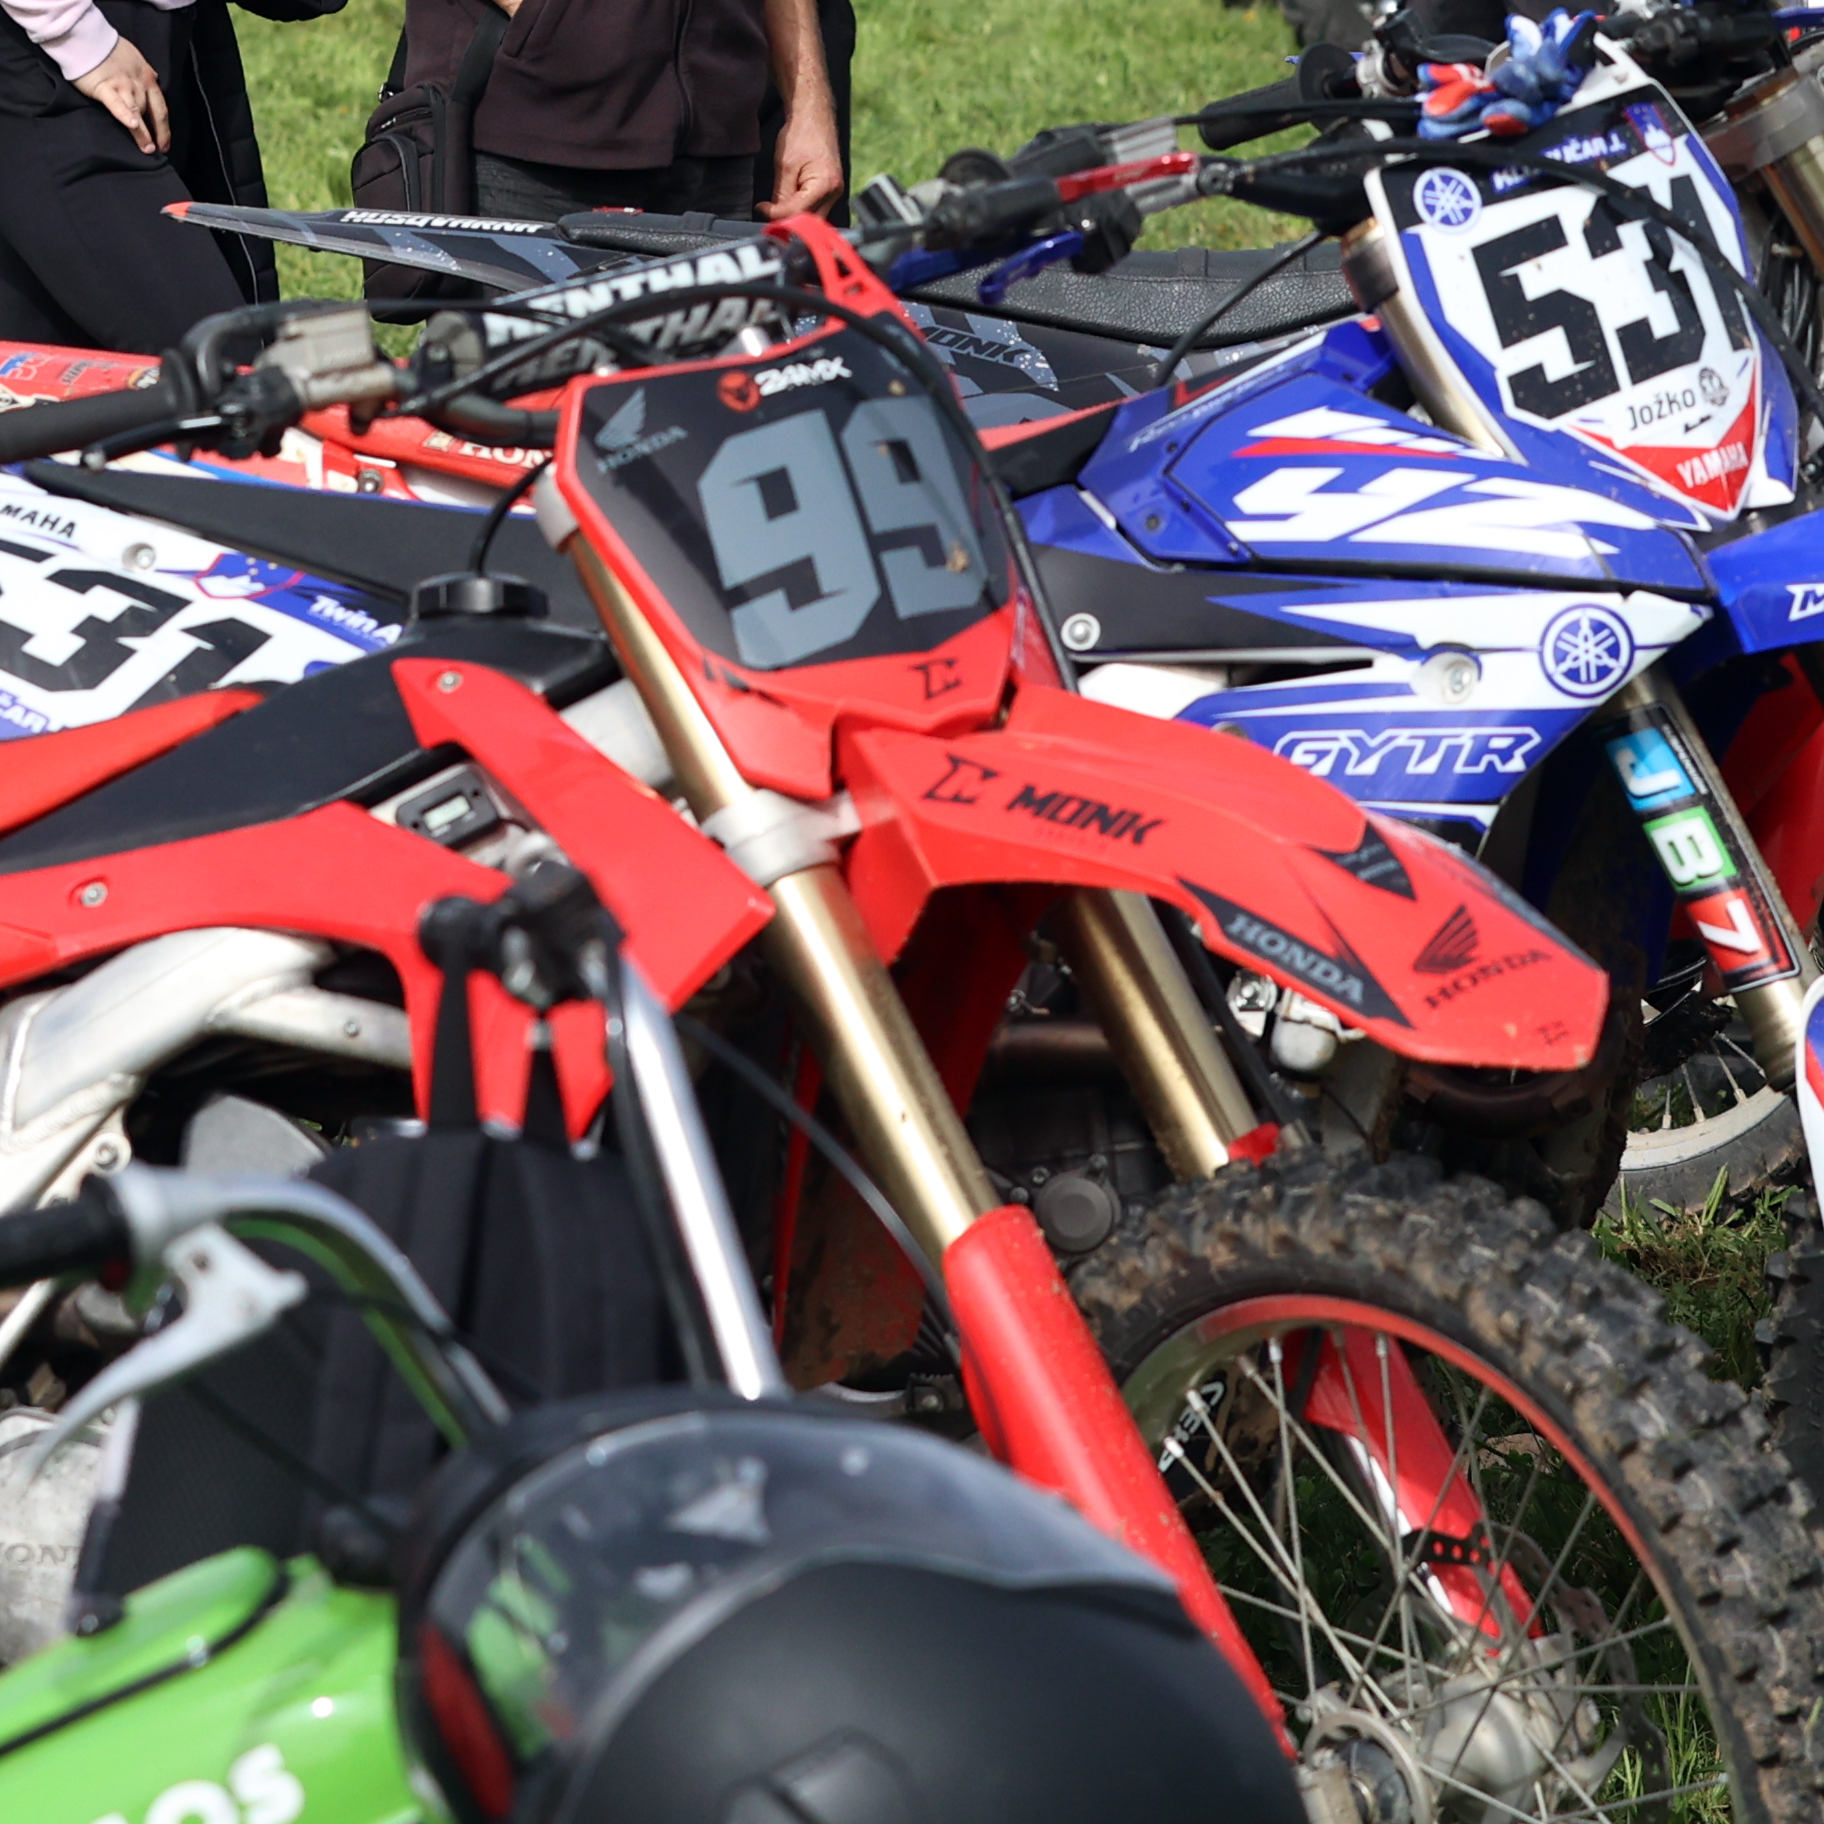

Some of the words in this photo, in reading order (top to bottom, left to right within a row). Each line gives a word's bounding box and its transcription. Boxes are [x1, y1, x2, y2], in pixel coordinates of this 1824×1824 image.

[1471, 174, 1753, 420] 531
[1627, 387, 1697, 430] Jožko
[1677, 443, 1749, 489] YAMAHA
[698, 394, 989, 670] 99
[1274, 726, 1542, 776] GYTR
[1006, 783, 1166, 846] MONK
[1226, 912, 1365, 1005] HONDA
[1423, 947, 1553, 1011] HONDA
